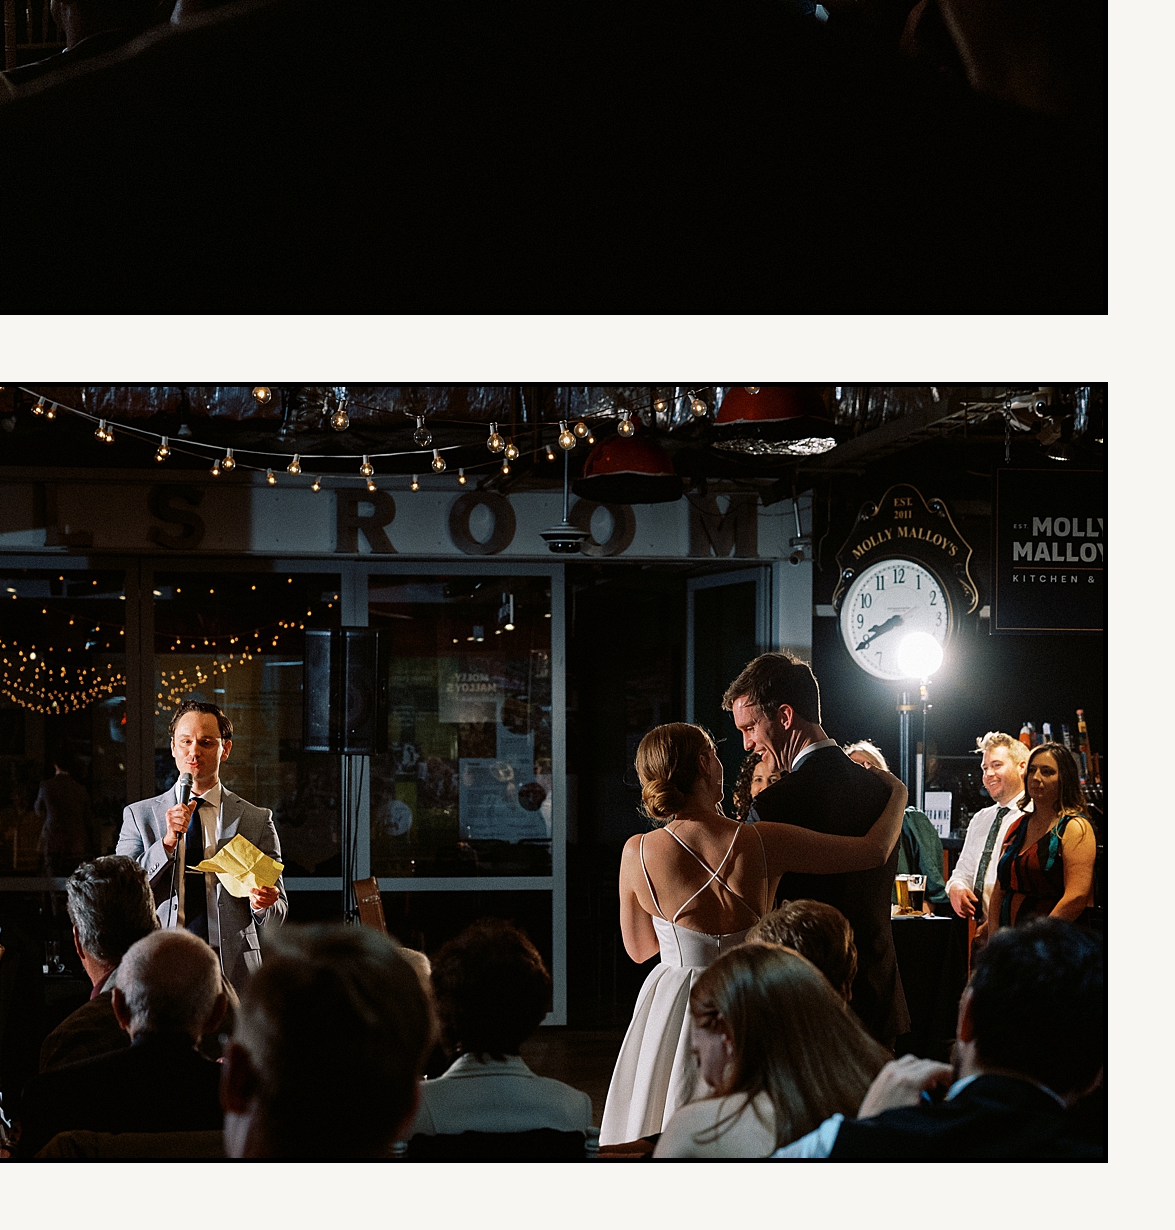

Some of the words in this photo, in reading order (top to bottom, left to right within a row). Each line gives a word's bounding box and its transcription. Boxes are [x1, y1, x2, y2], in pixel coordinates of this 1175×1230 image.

[334, 487, 759, 557] ROOM
[893, 510, 912, 519] 2011
[852, 528, 893, 560] MOLLY
[897, 526, 959, 557] MALLOY'S
[876, 575, 885, 590] 11
[893, 568, 905, 584] 12
[916, 574, 921, 590] 1
[1012, 574, 1078, 584] KITCHEN
[1087, 575, 1095, 584] &
[861, 592, 872, 608] 10
[930, 590, 937, 606] 2
[857, 613, 864, 629] 9
[935, 611, 942, 627] 3
